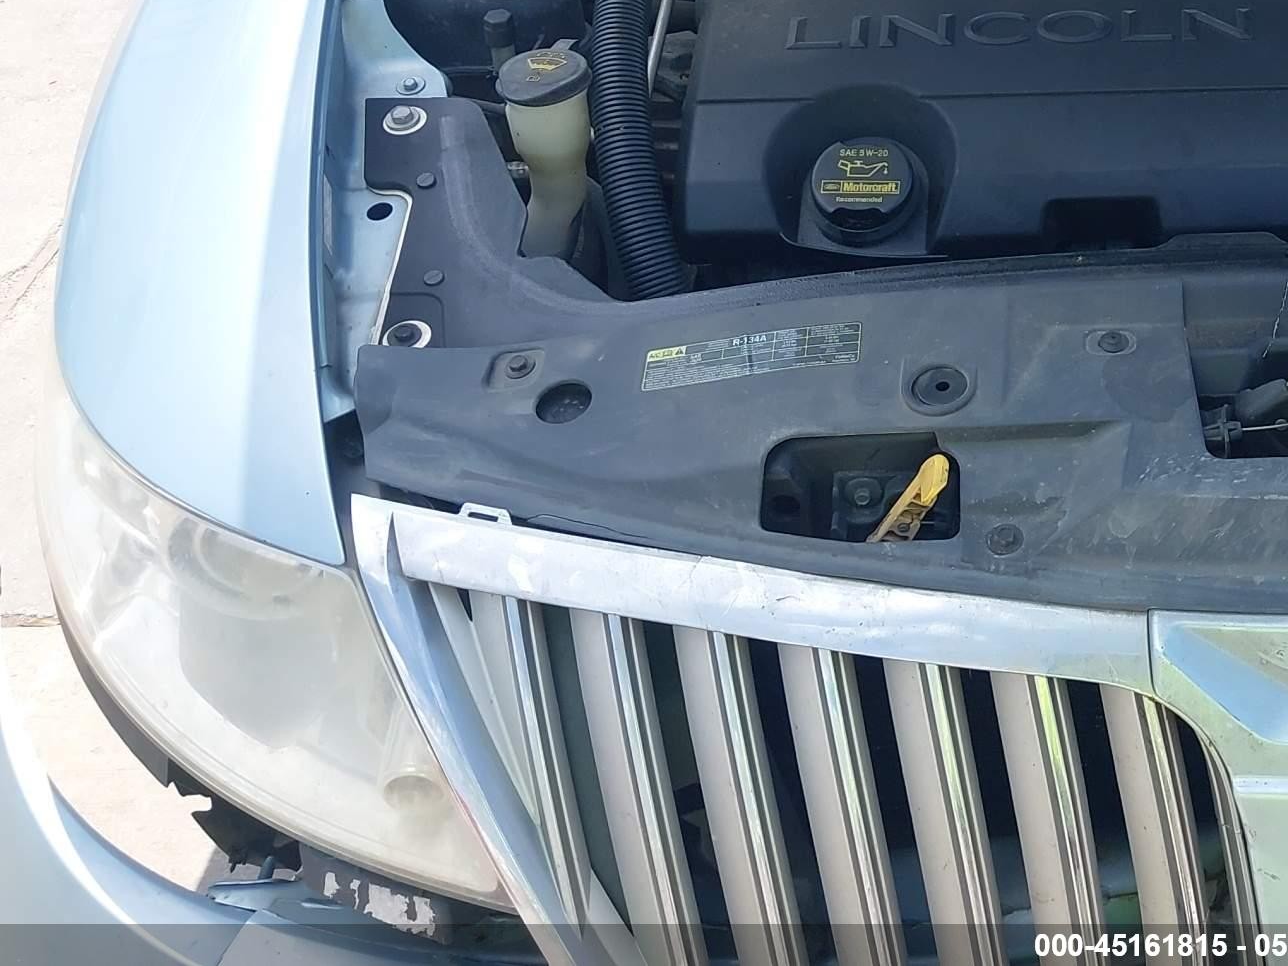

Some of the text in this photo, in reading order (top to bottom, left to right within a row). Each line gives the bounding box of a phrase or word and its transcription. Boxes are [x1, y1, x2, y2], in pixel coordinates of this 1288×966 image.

[785, 7, 1254, 50] LINCOLN
[839, 149, 858, 157] SAE
[843, 181, 898, 193] Motorcraft
[732, 334, 767, 347] R-134A
